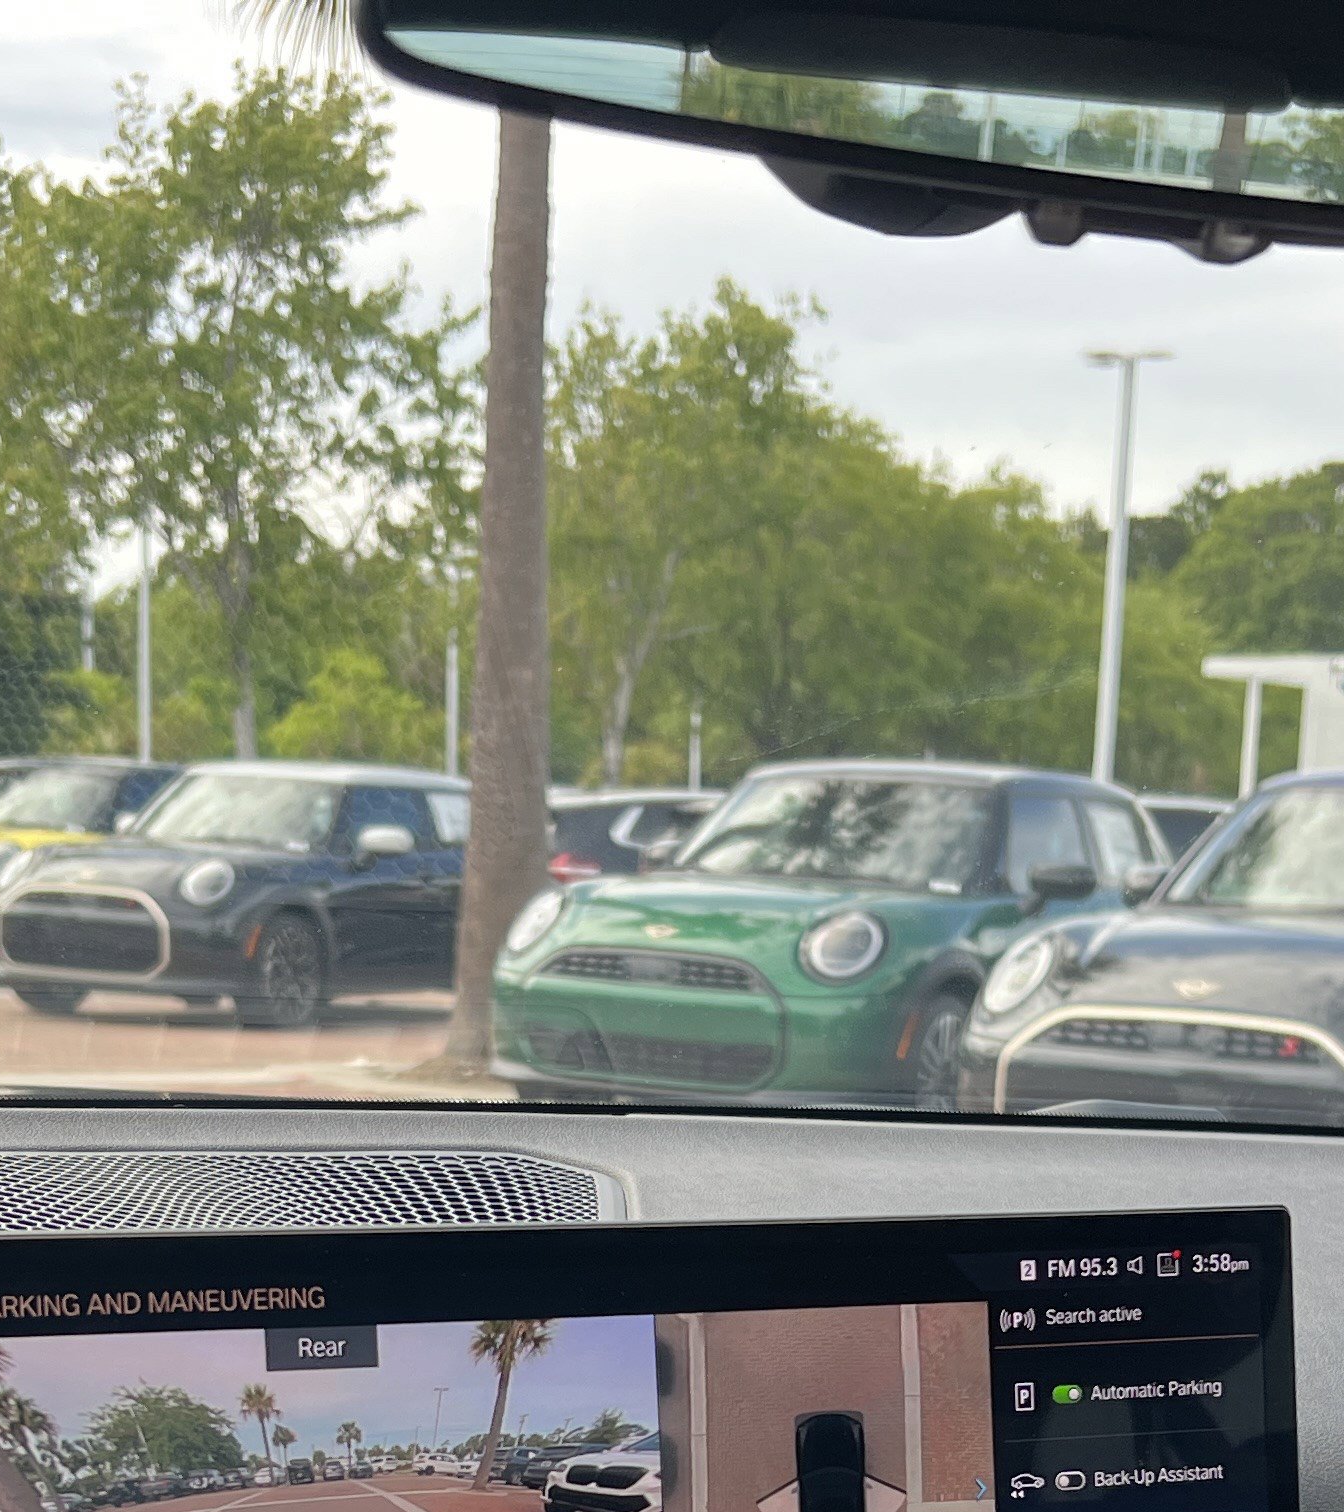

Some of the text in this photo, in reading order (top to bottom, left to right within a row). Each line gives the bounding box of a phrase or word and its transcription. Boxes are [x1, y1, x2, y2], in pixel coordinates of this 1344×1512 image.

[1047, 1259, 1076, 1278] FM
[1080, 1257, 1118, 1277] 95.3
[1191, 1253, 1250, 1274] 3:58pm
[87, 1292, 142, 1316] AND
[147, 1286, 327, 1315] MANEUVERING
[1045, 1307, 1096, 1325] Search
[1099, 1306, 1143, 1323] active
[297, 1337, 346, 1359] Rear
[1090, 1382, 1165, 1402] Automatic
[1168, 1380, 1223, 1399] Parking
[1094, 1464, 1224, 1488] Back-Up Assistant
